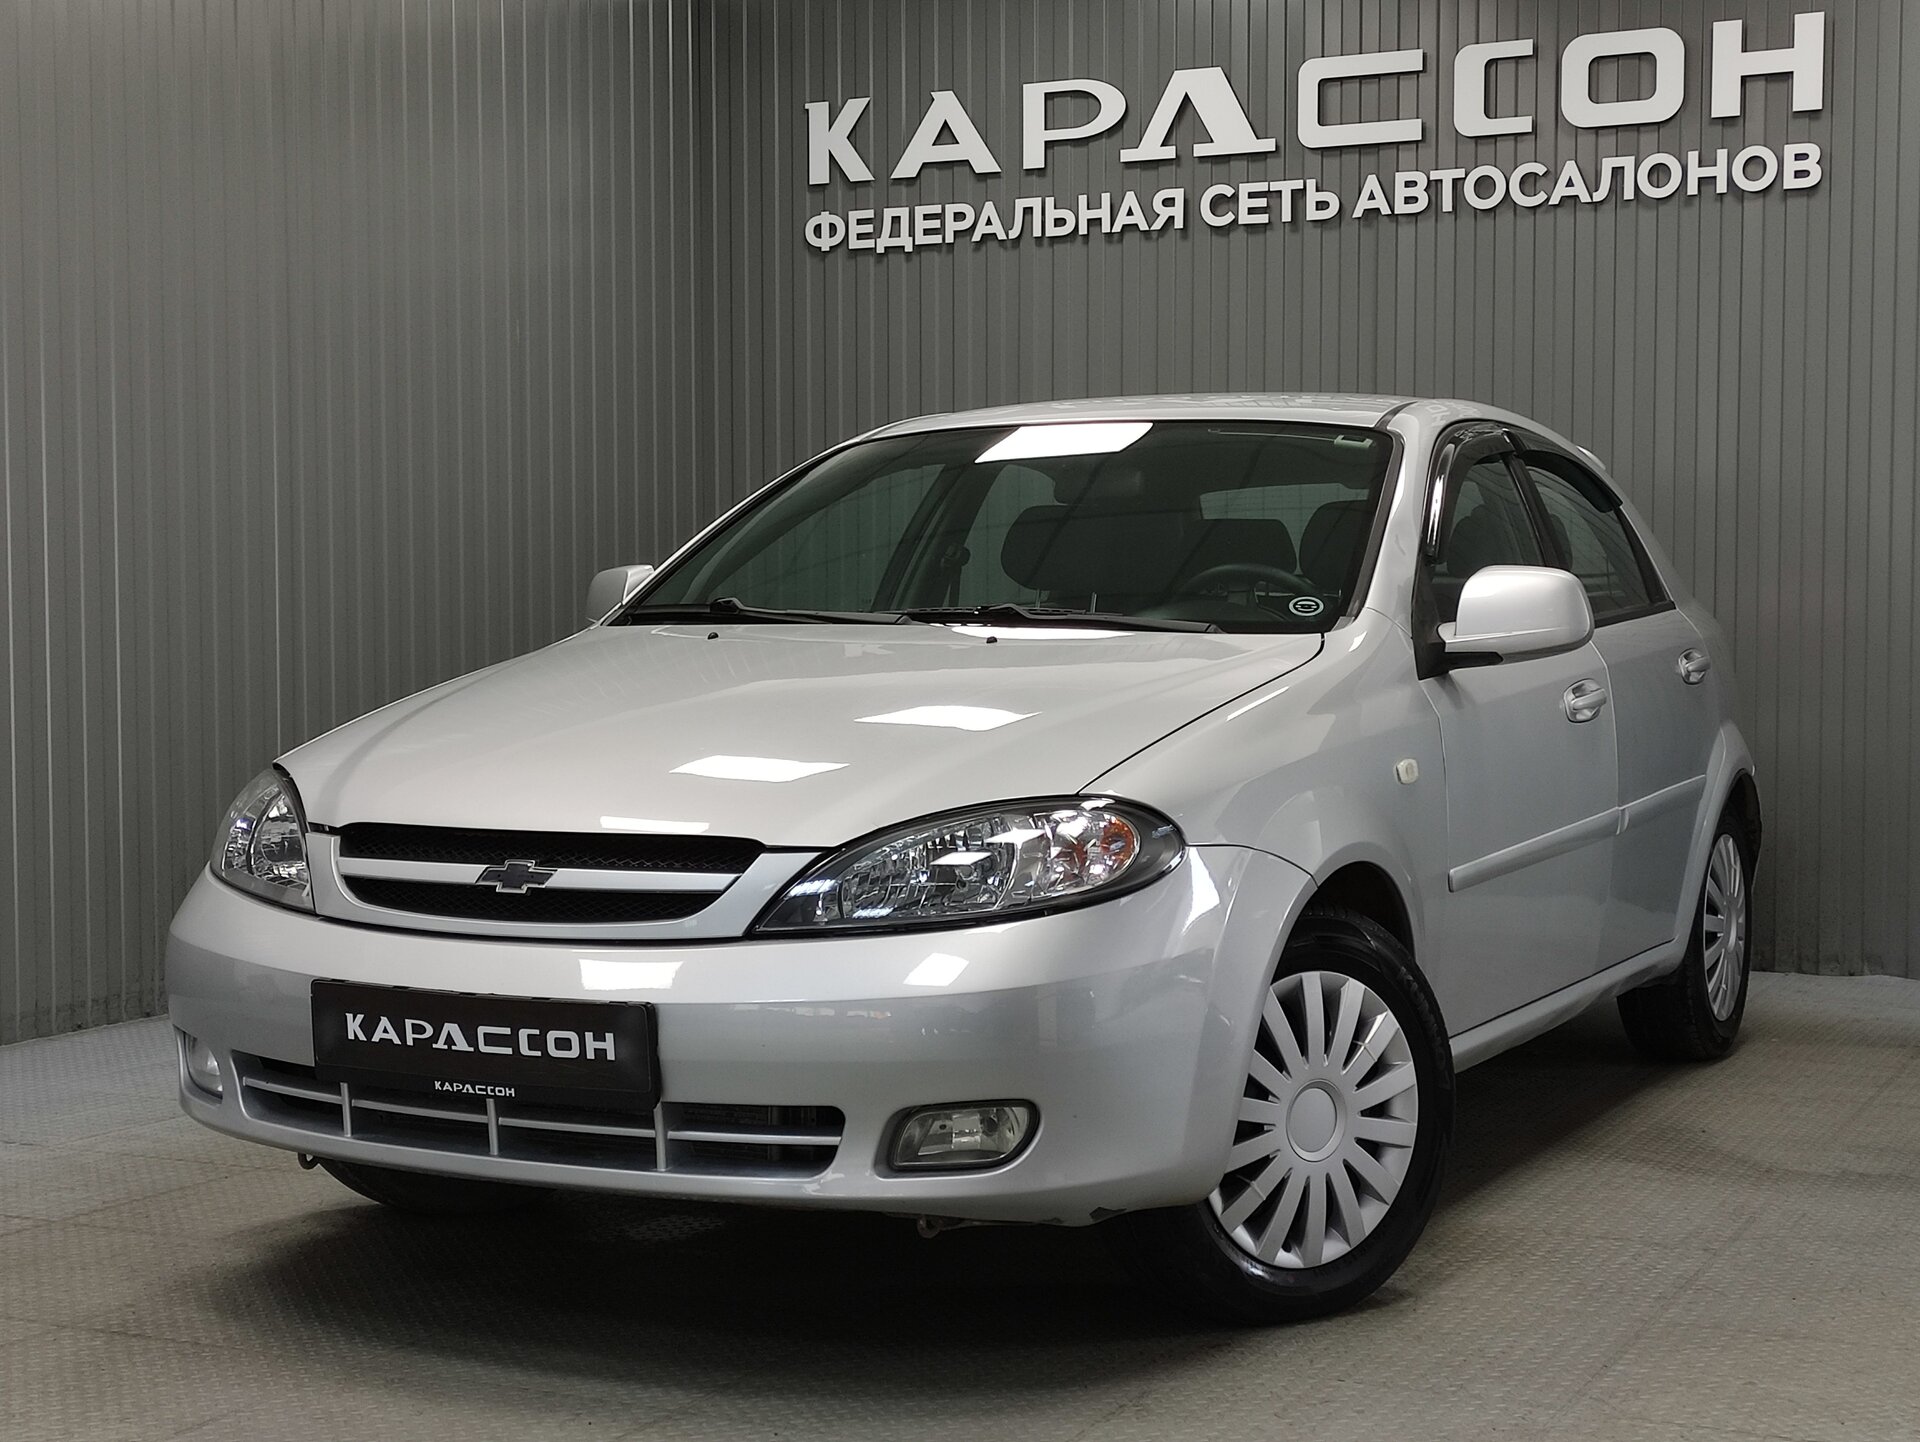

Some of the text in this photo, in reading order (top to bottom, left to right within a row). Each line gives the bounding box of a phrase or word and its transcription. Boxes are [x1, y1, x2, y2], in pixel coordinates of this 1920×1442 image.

[805, 142, 1822, 254] ФЕДЕРАЛЬНАЯ СЕТЬ АВТОСАЛОНОВ
